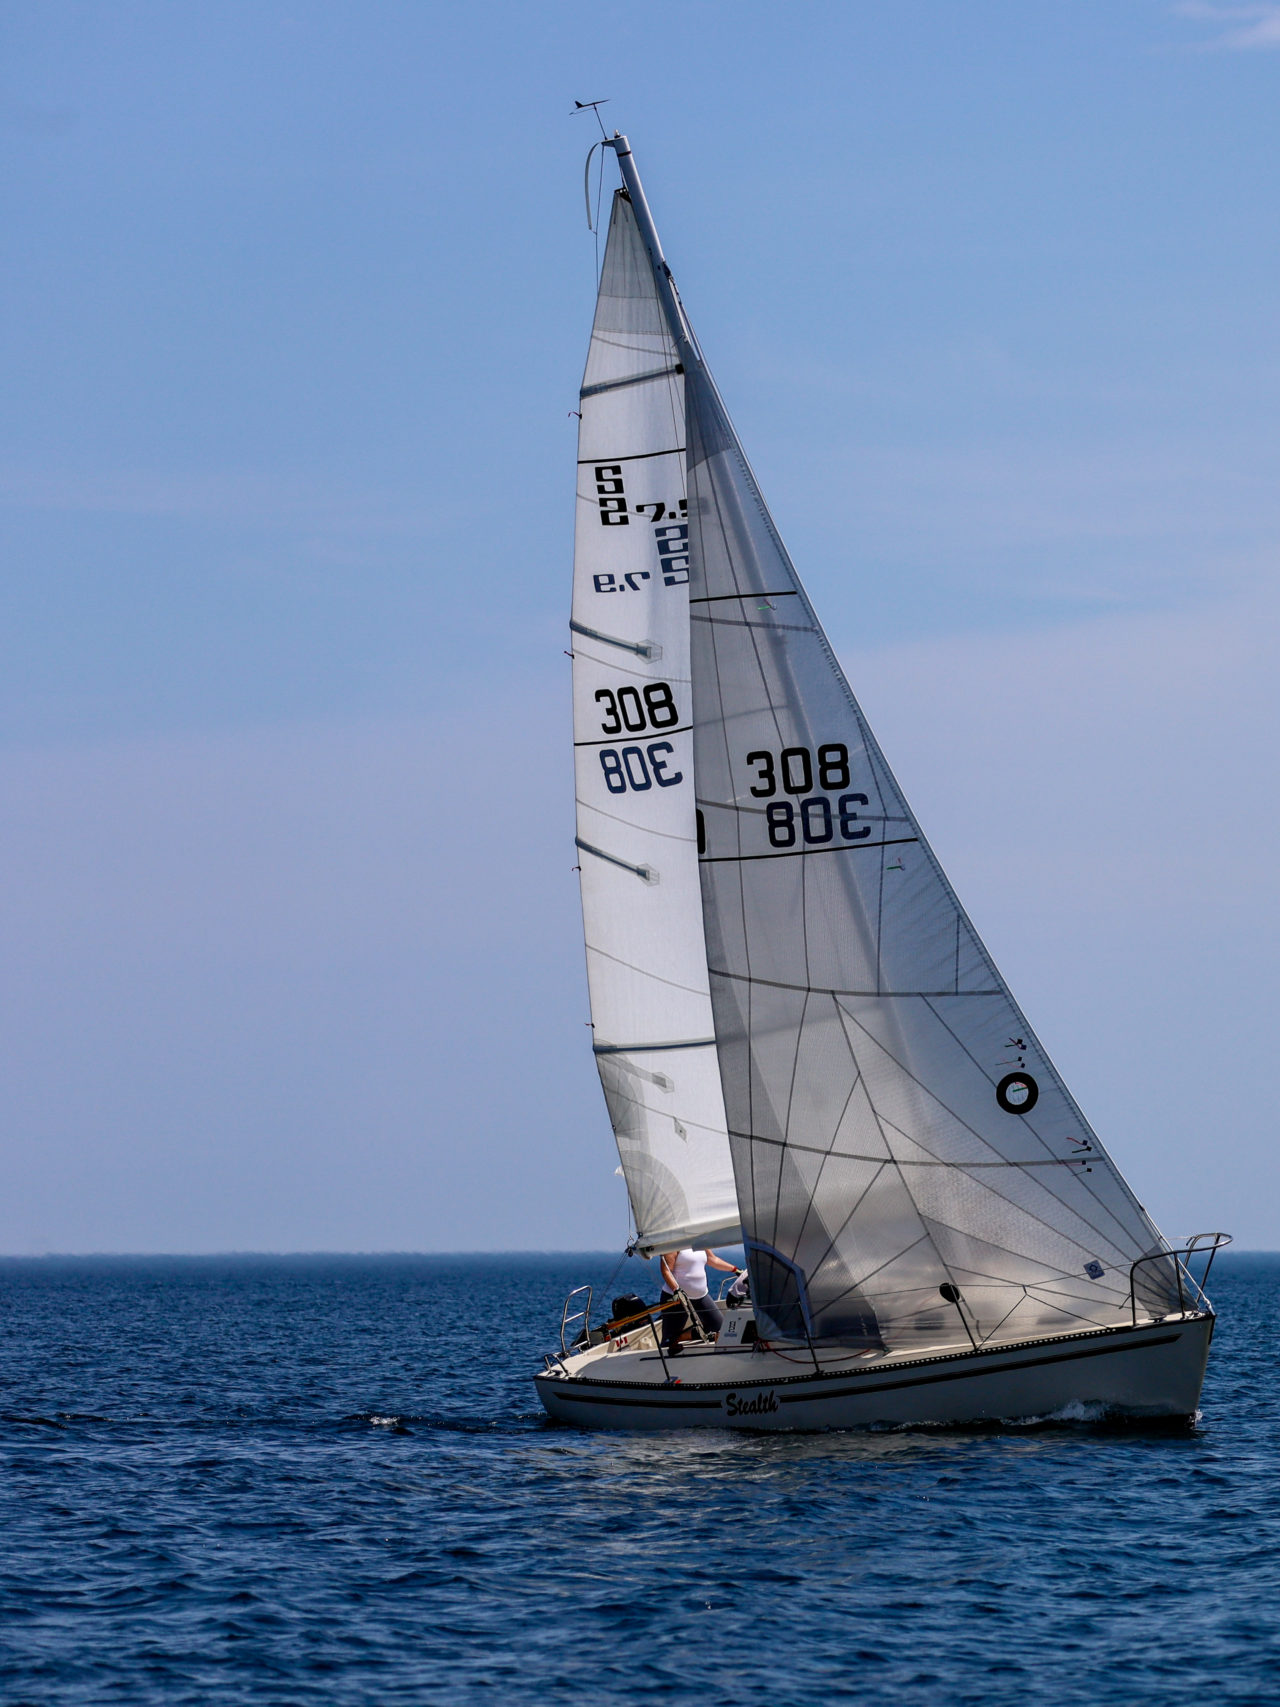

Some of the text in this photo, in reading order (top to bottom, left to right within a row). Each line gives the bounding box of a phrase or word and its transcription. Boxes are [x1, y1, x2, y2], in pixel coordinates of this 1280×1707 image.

[595, 682, 679, 734] 308
[747, 743, 850, 797] 308
[726, 1389, 779, 1416] Stealth
